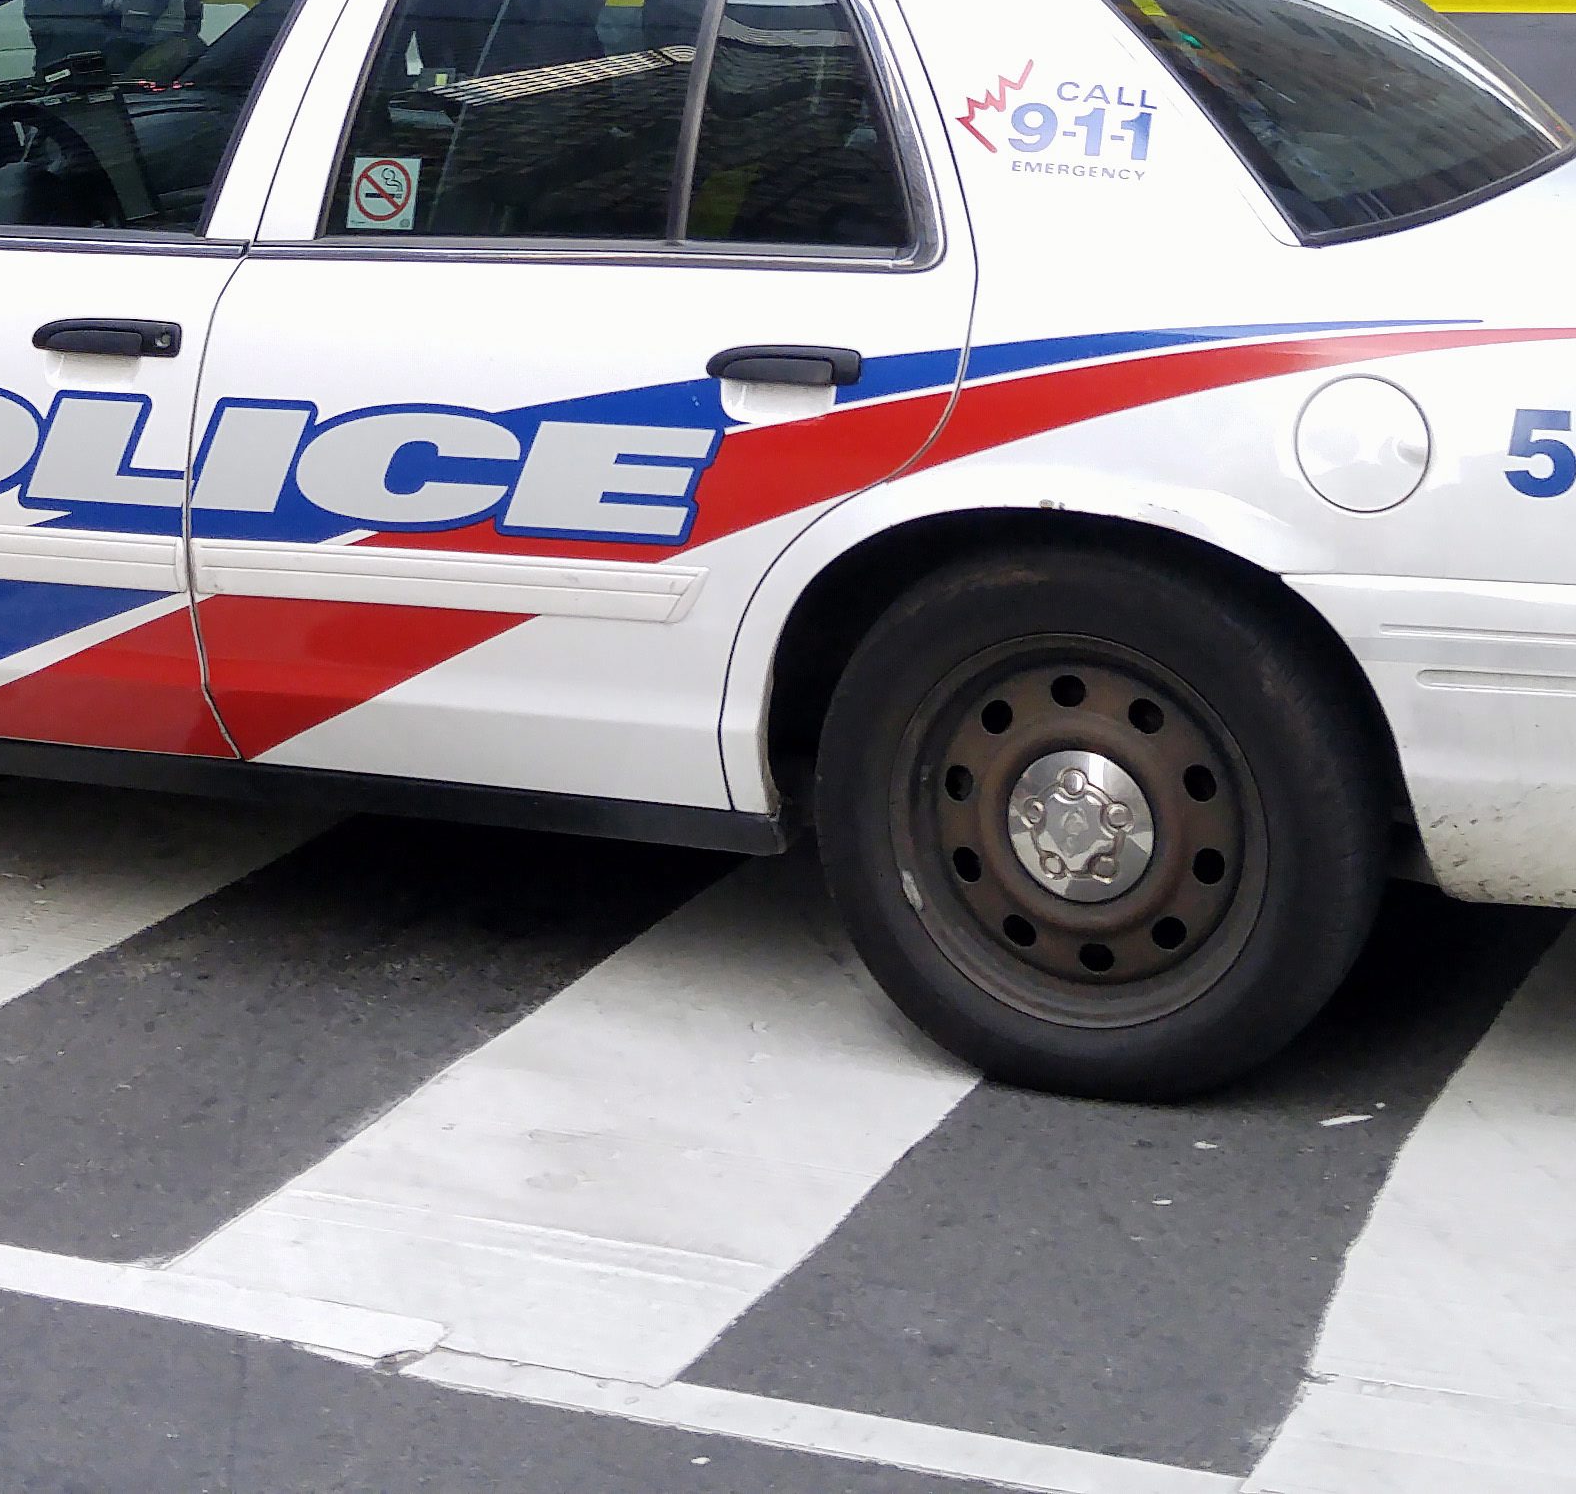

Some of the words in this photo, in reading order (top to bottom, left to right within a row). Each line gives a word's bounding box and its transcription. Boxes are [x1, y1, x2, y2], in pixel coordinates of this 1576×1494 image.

[1057, 81, 1157, 110] CALL
[1008, 102, 1153, 161] 9-1-1
[1011, 159, 1146, 181] EMERGENCY
